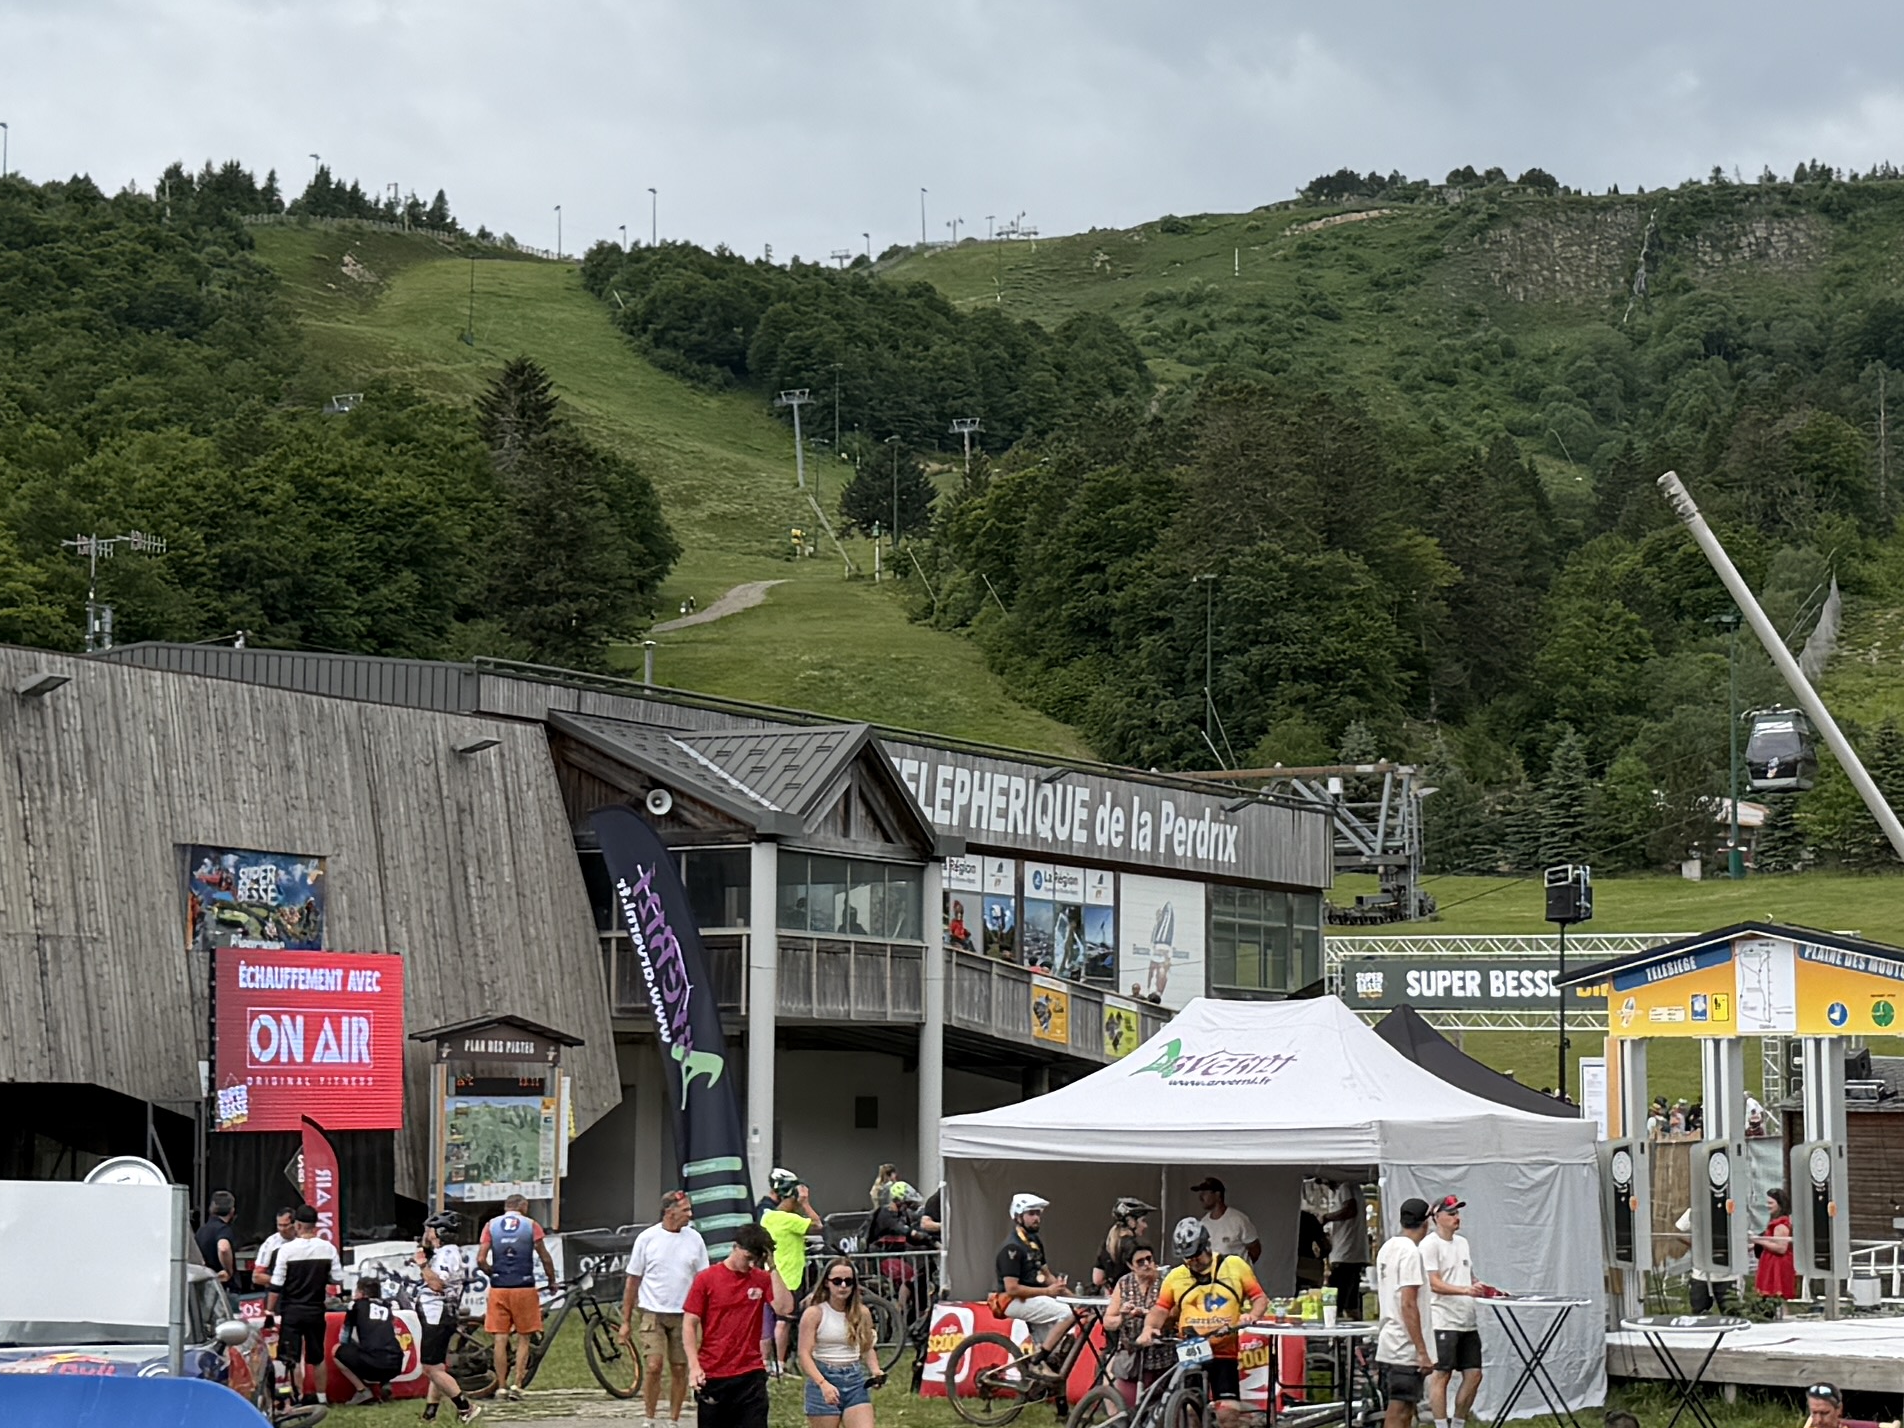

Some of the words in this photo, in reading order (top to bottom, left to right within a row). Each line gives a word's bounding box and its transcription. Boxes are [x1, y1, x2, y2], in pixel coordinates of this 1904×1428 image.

[1095, 791, 1124, 848] de
[1131, 796, 1152, 852] la
[1159, 800, 1238, 863] Perdrix
[949, 858, 977, 876] Région
[237, 879, 279, 906] BESSE
[1804, 945, 1842, 965] PLAINE
[1844, 954, 1866, 971] DES
[239, 960, 343, 991] ÉCHAUFFEMENT
[347, 969, 381, 992] AVEC
[1406, 970, 1481, 997] SUPER
[1490, 970, 1561, 997] BESSE
[250, 1014, 304, 1063] ON
[312, 1016, 371, 1063] AIR
[464, 1040, 486, 1052] PLAN
[487, 1041, 504, 1053] DES
[506, 1041, 534, 1054] PISTES
